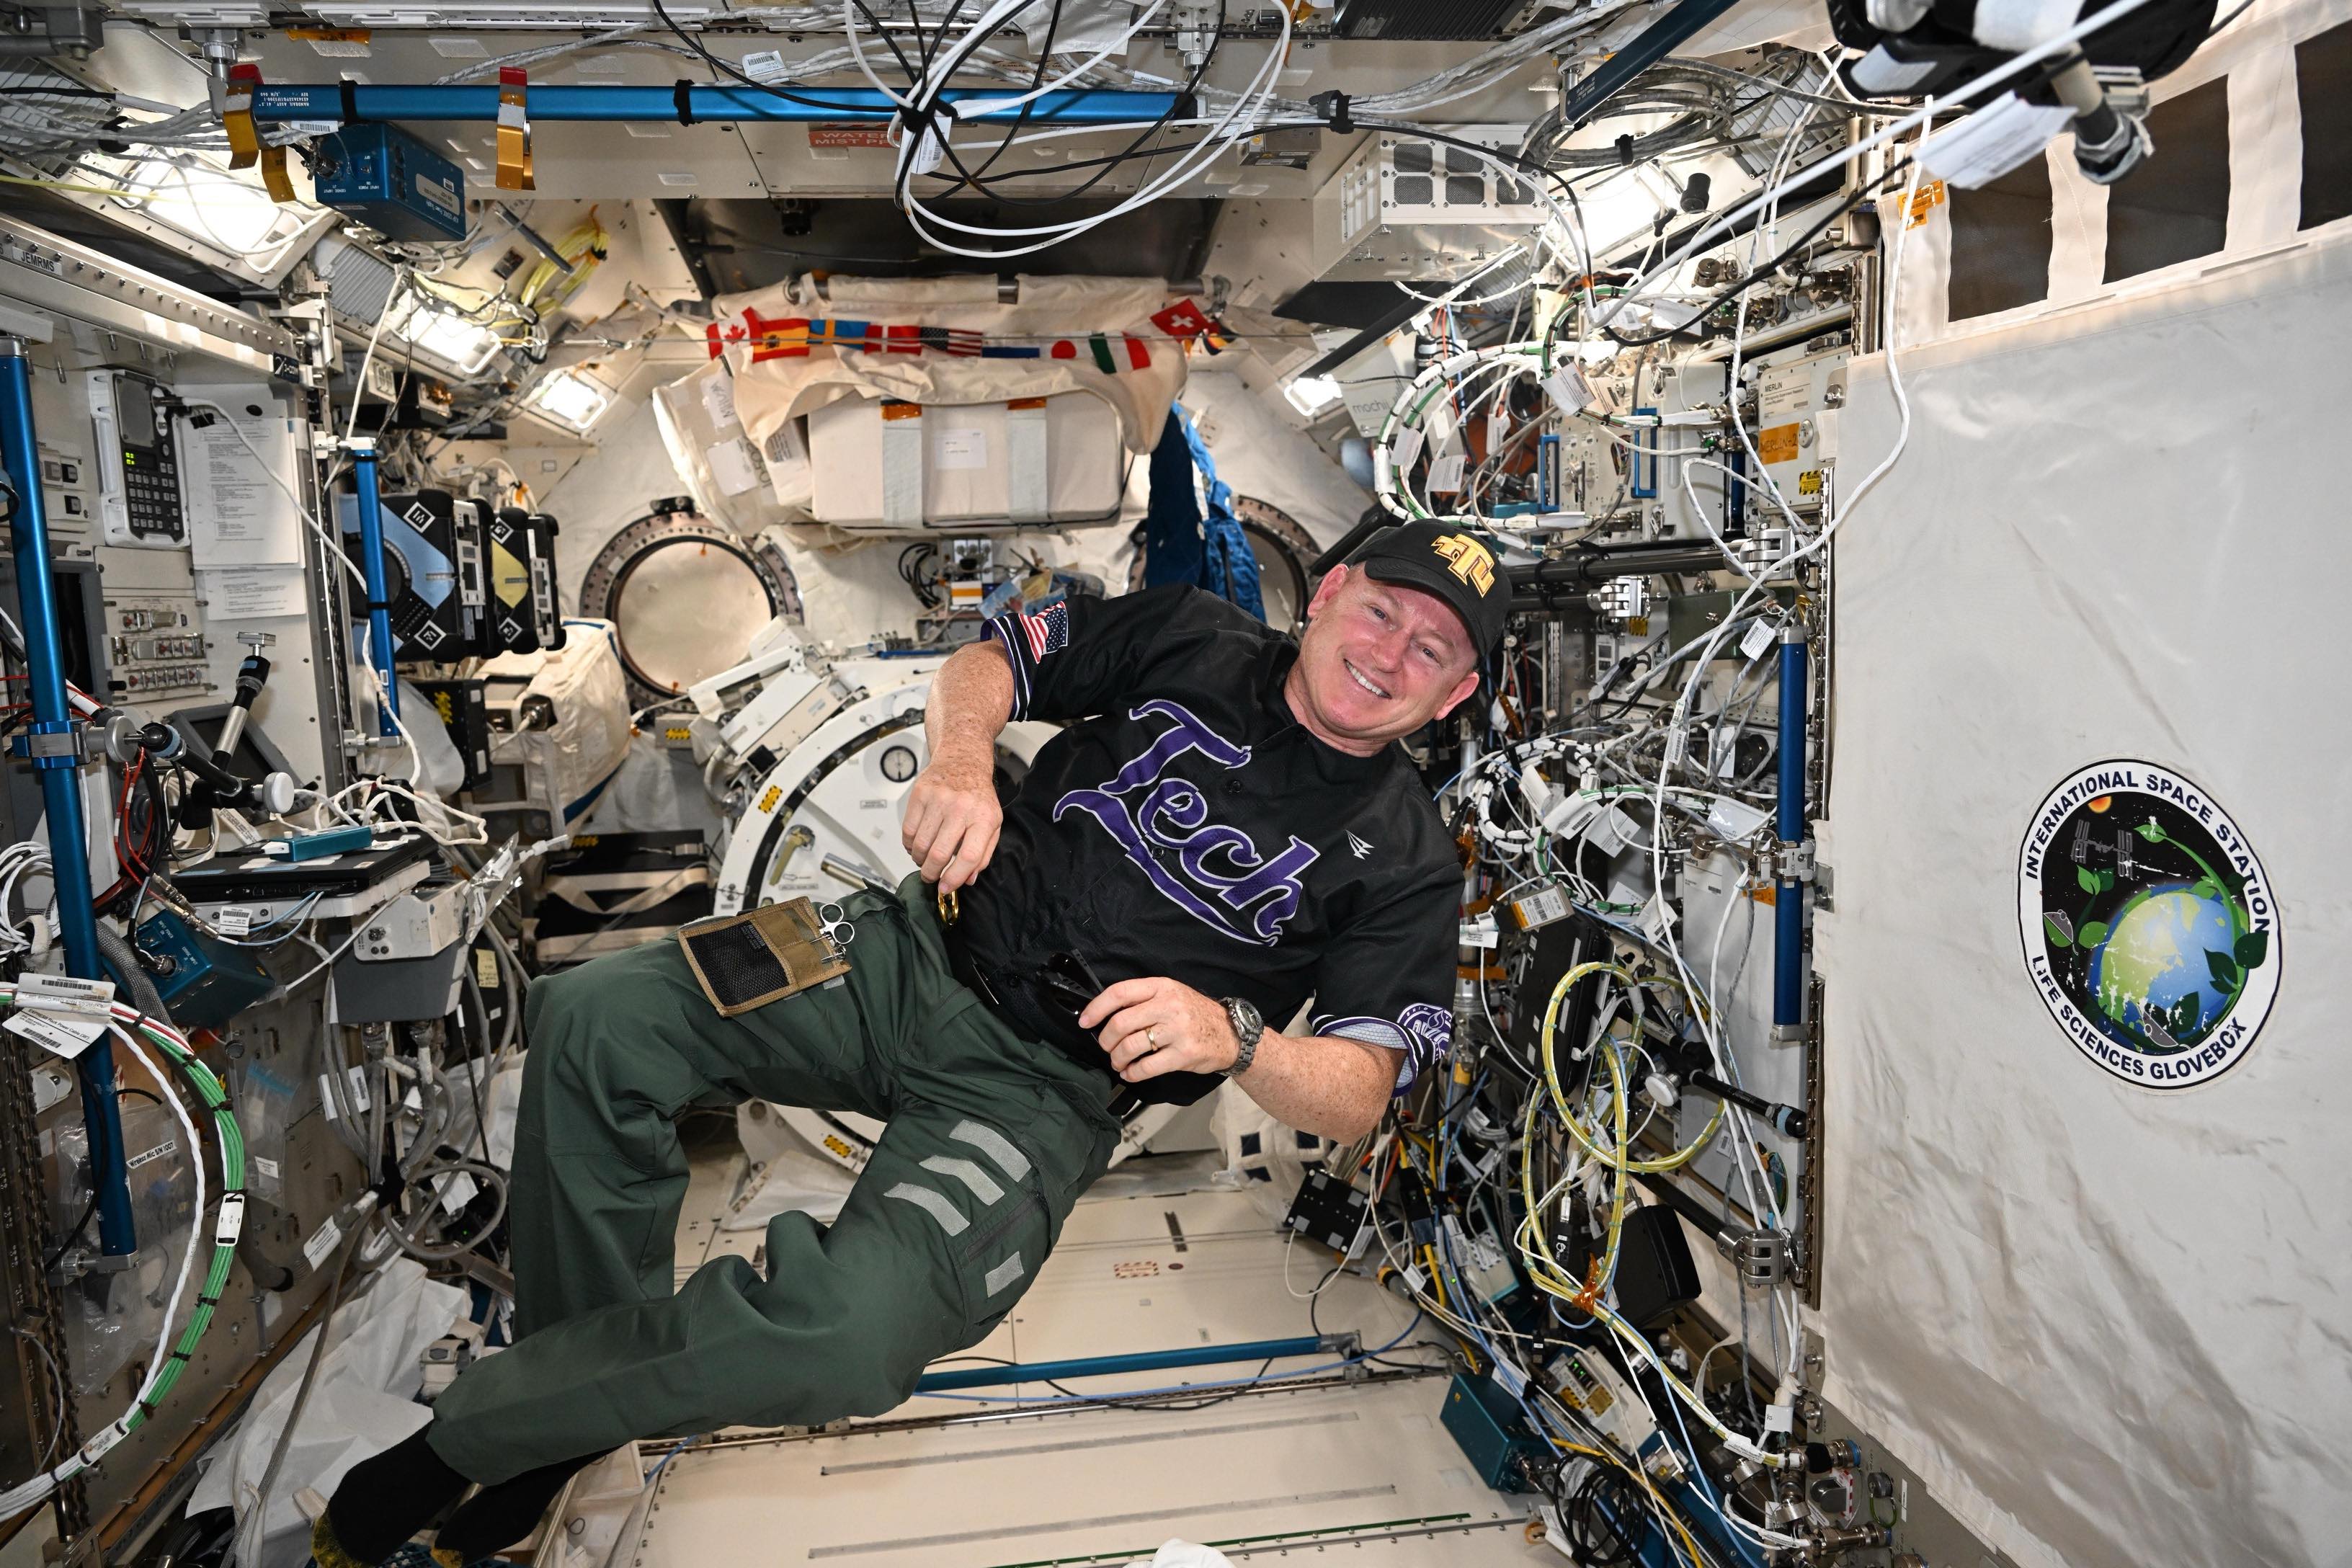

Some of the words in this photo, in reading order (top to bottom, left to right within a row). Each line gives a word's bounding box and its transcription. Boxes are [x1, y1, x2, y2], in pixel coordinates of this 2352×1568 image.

[21, 251, 55, 272] JEMRMS
[1765, 381, 1783, 392] MERLIN
[1760, 433, 1798, 453] MERLIN-2
[1053, 698, 1320, 946] Tech
[2026, 770, 2139, 881] INTERNATIONAL
[2146, 773, 2214, 821] SPACE
[2215, 822, 2271, 935] STATION
[28, 1008, 48, 1020] EXPRESS
[48, 1017, 58, 1025] Rack
[58, 1022, 69, 1031] Power
[68, 1028, 81, 1036] Cable
[2031, 955, 2060, 1005] LIFE
[2059, 1002, 2144, 1077] SCIENCES
[2150, 1018, 2248, 1079] GLOVEBOX
[129, 1156, 147, 1167] Wireless
[146, 1151, 156, 1159] Mic
[163, 1142, 174, 1152] 1007
